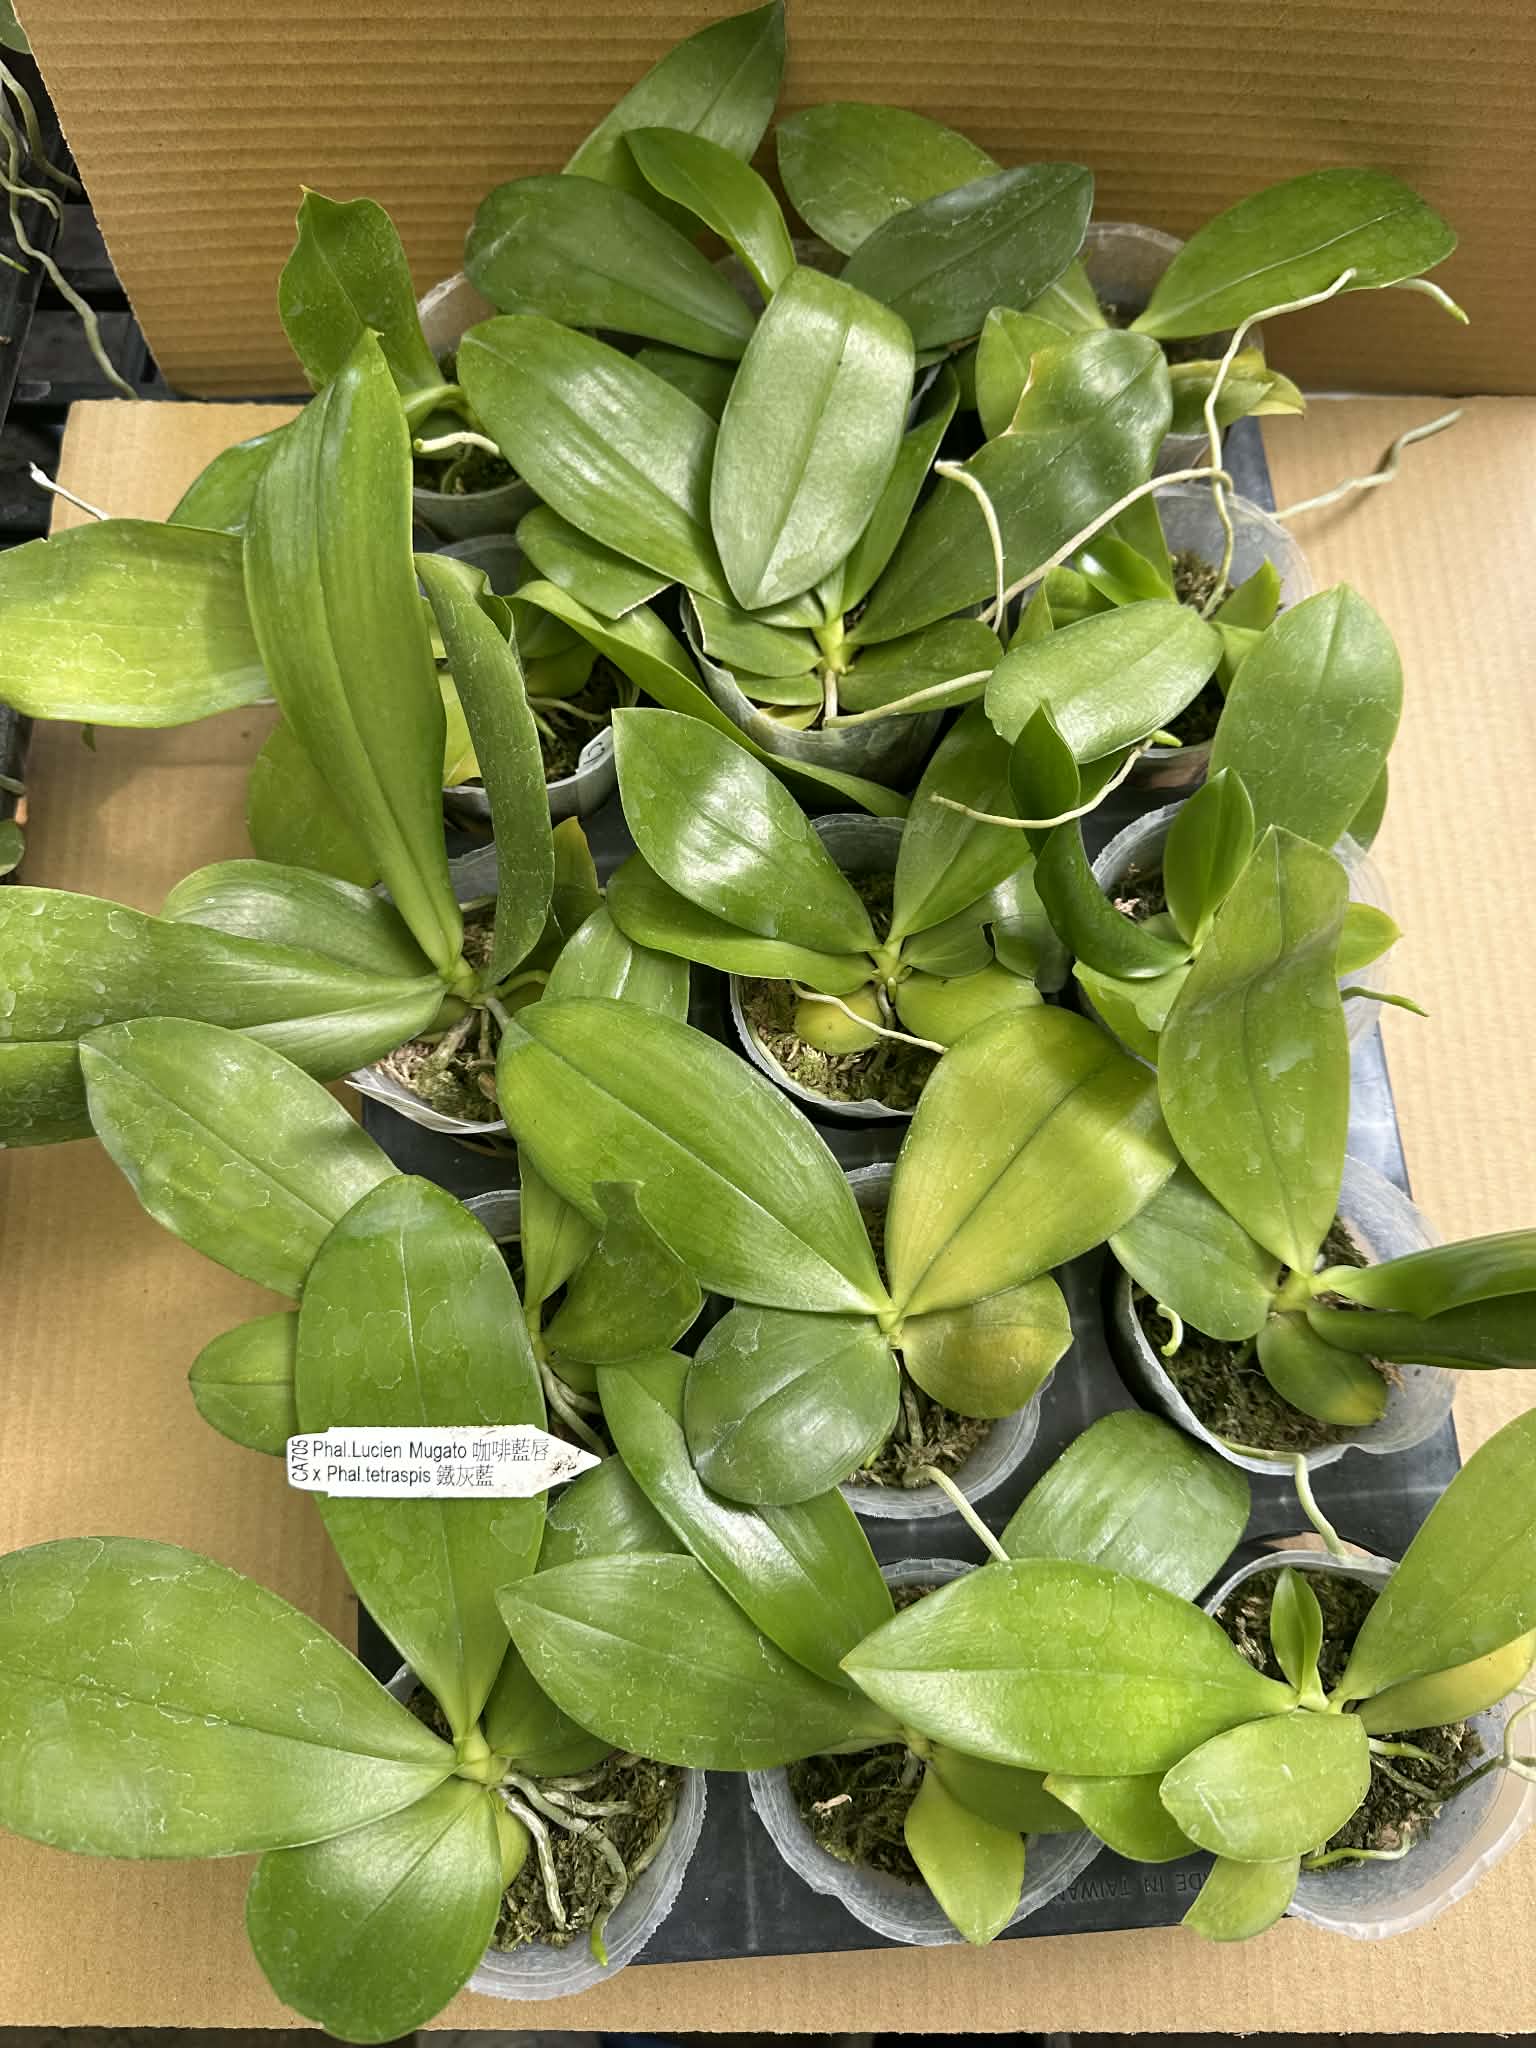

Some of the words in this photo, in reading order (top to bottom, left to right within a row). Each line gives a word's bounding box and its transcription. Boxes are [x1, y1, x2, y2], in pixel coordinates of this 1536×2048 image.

[292, 1440, 309, 1482] CA705
[313, 1440, 402, 1458] Phal.Lucien
[409, 1441, 467, 1463] Mugato
[472, 1437, 550, 1463] 咖啡藍唇
[312, 1468, 321, 1482] x
[327, 1465, 431, 1487] Phal.tetraspis
[1143, 1875, 1166, 1894] IN
